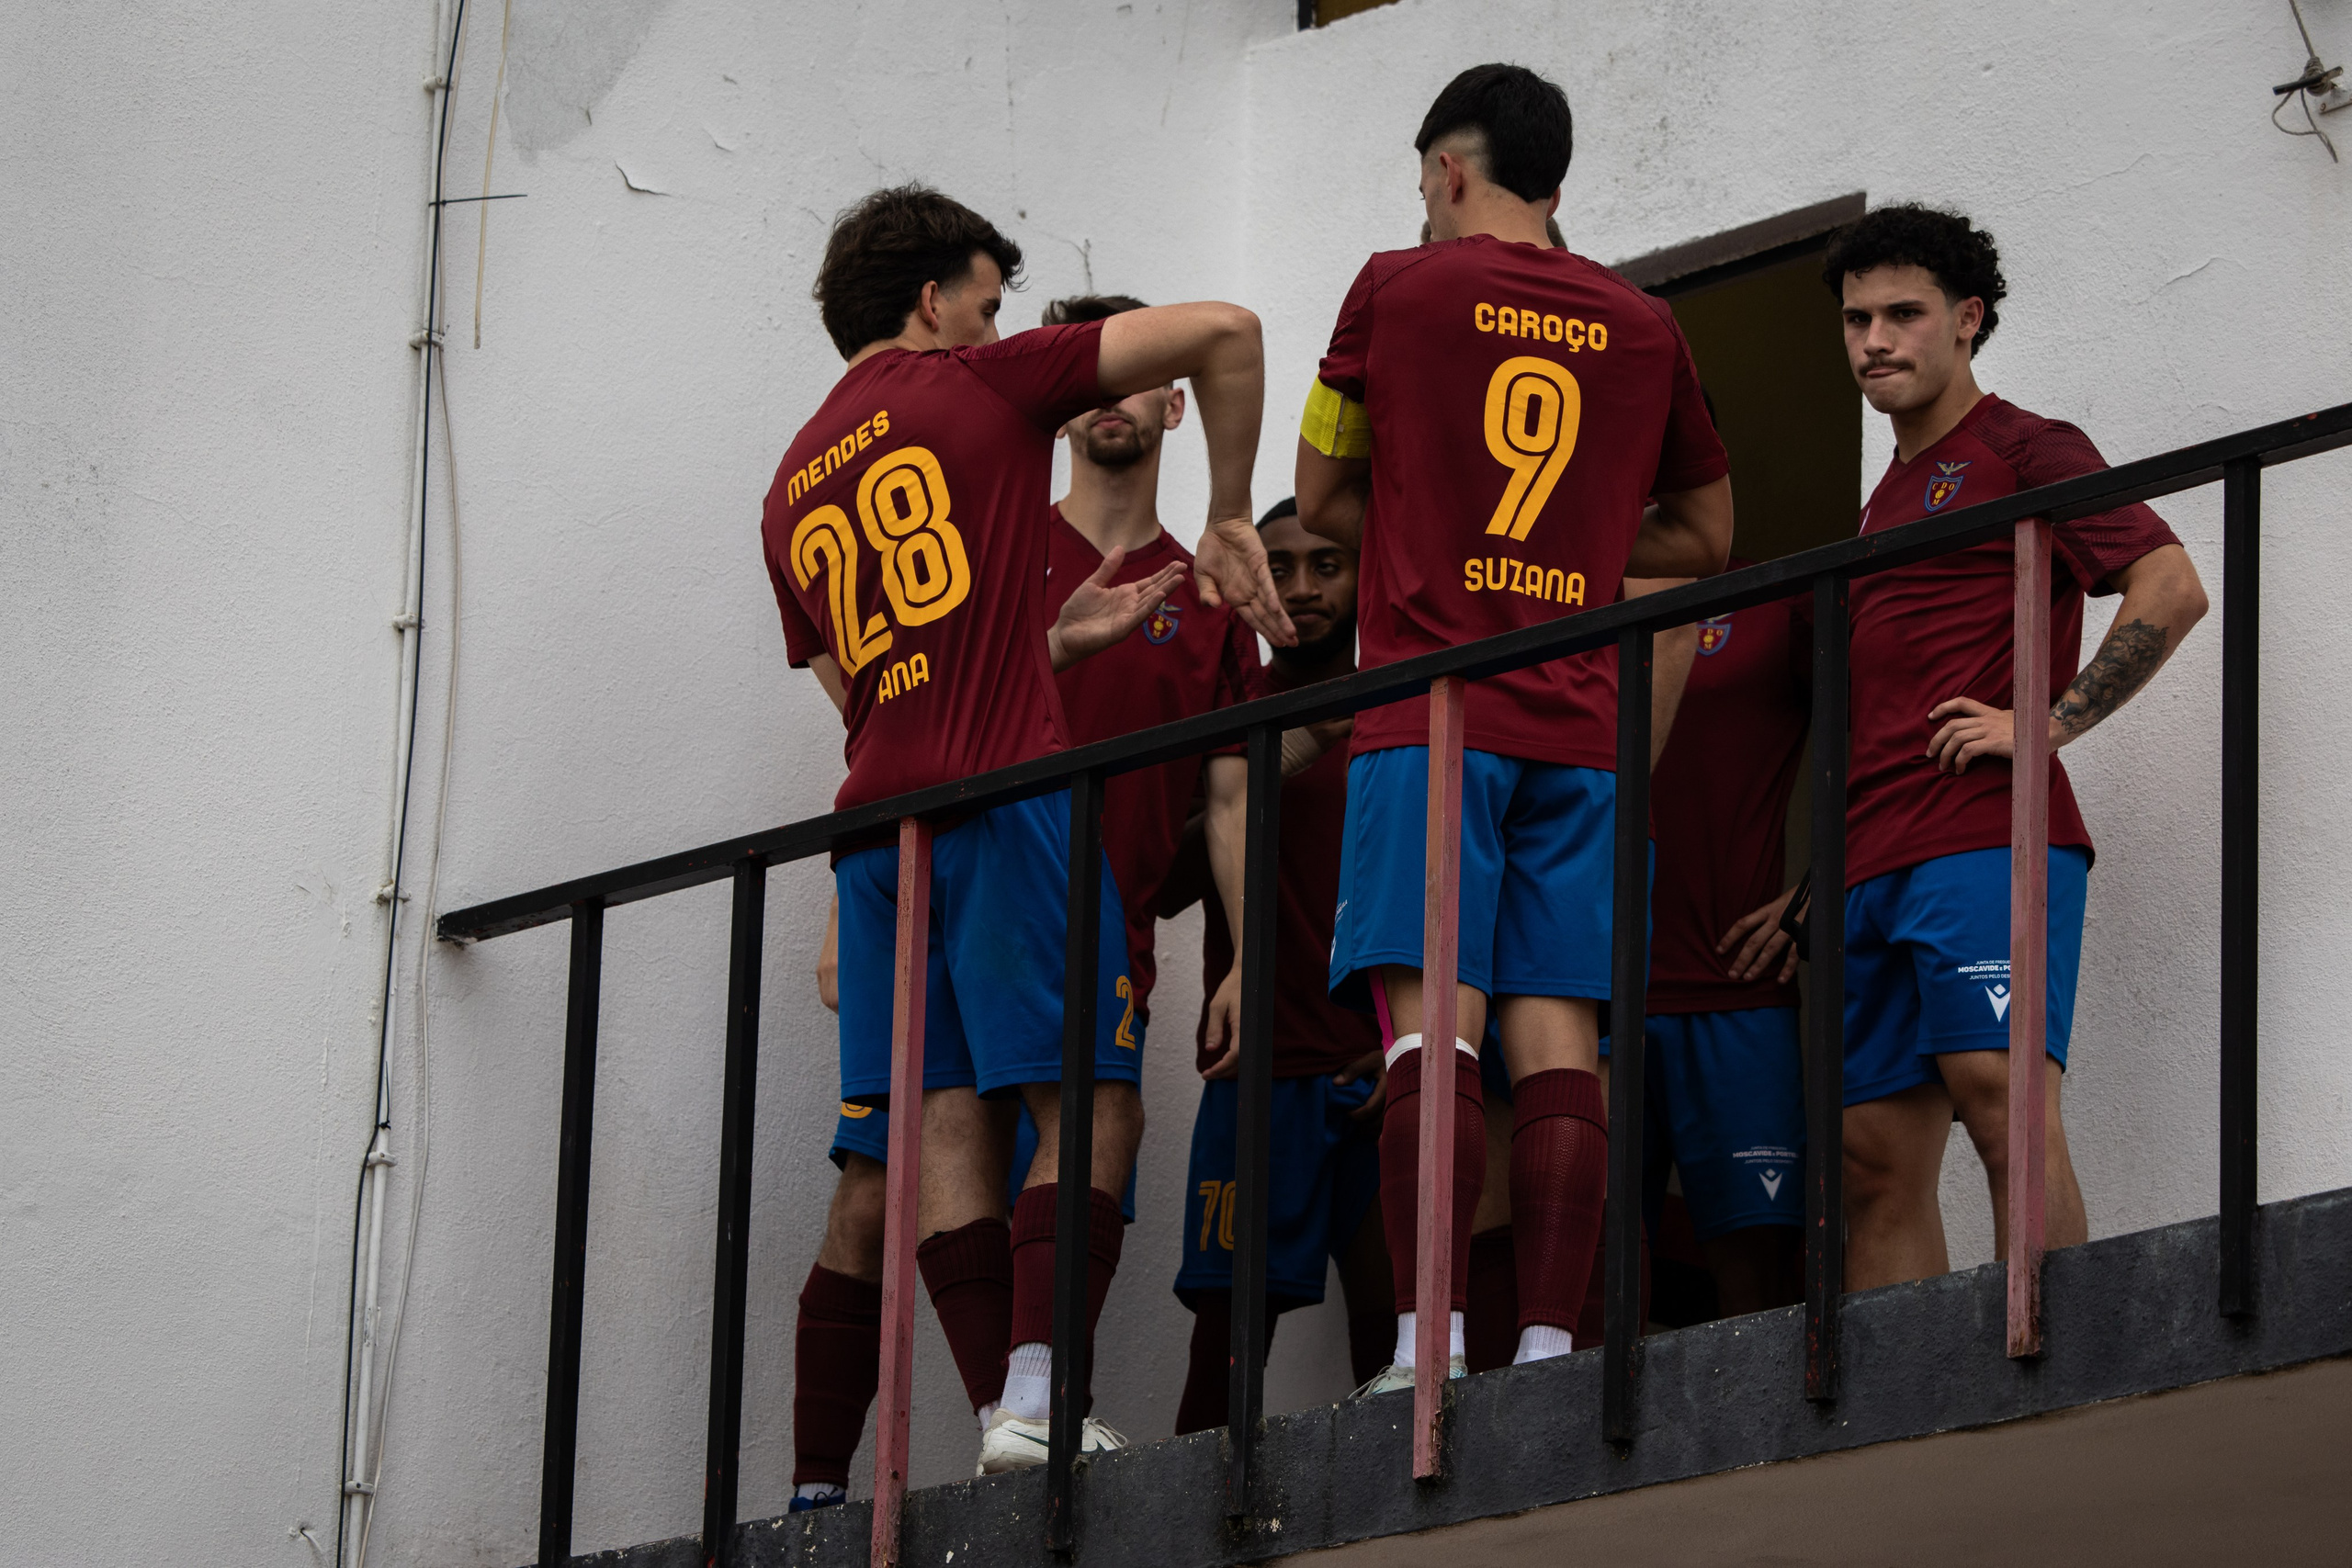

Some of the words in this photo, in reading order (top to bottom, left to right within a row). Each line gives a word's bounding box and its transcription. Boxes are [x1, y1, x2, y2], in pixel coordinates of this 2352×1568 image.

[1475, 302, 1608, 353] CAROÇO
[787, 410, 890, 507] MENDES
[1484, 355, 1581, 542] 9
[790, 446, 971, 679] 28
[1464, 557, 1586, 606] SUZANA
[878, 652, 930, 705] ANA
[1114, 976, 1136, 1051] 2
[1732, 1150, 1772, 1158] MOSCAVIDE
